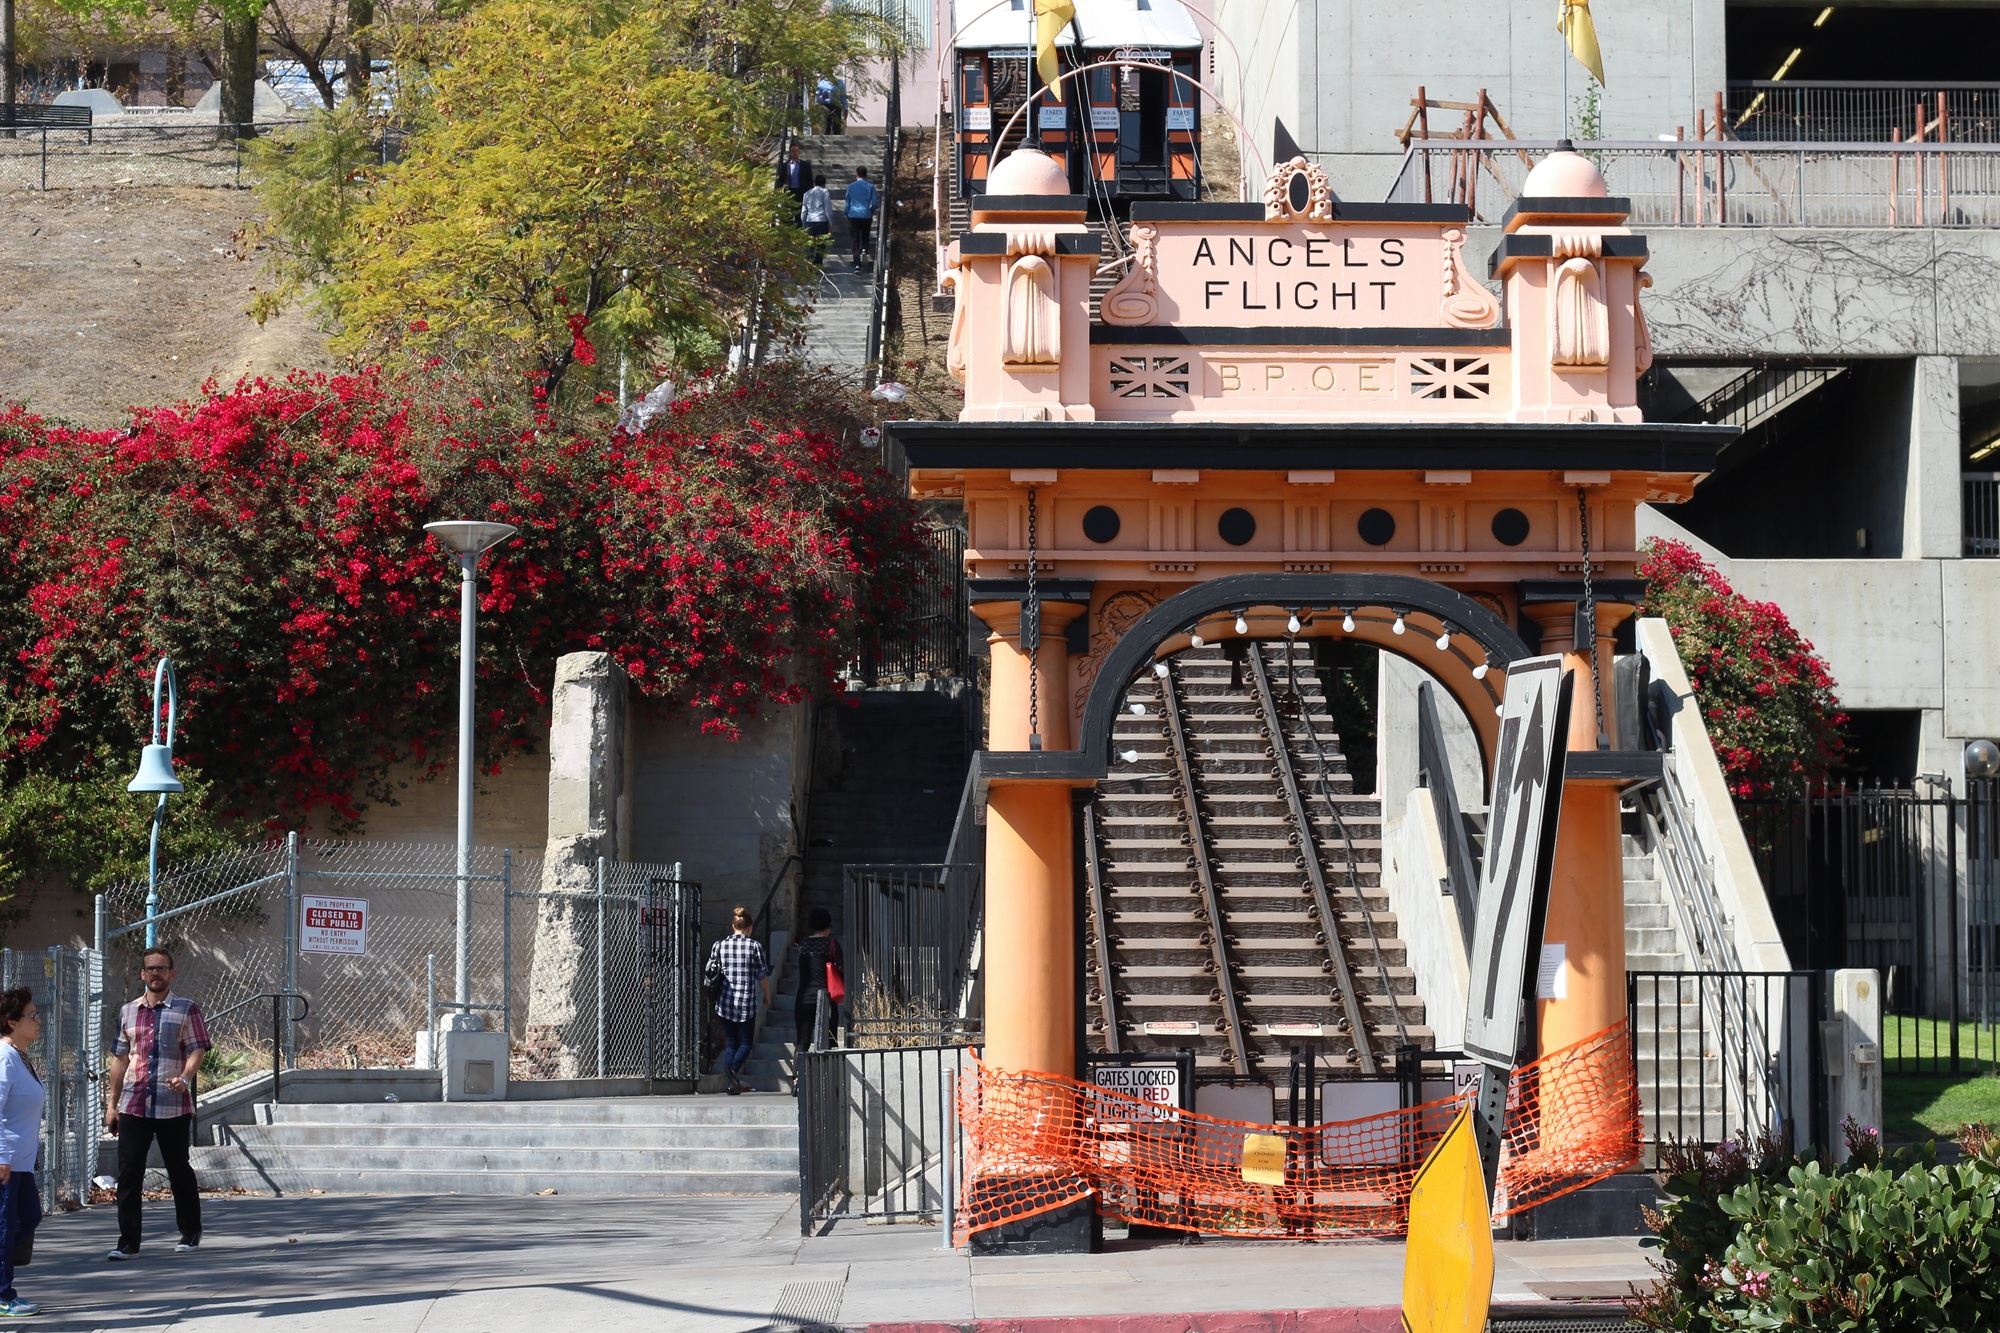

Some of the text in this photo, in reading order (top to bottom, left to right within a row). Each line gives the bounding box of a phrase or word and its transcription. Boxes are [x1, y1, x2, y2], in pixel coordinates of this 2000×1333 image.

[1192, 237, 1405, 267] ANGELS
[1205, 280, 1396, 310] FLIGHT
[316, 900, 355, 909] THIS PROPERTY
[312, 910, 357, 920] CLOSED TO
[310, 918, 358, 928] THE PUBLIC
[308, 936, 358, 946] WITHOUT PERMISSION
[1097, 1070, 1176, 1086] GATES LOCKED
[1102, 1087, 1170, 1101] WHEN RED
[1101, 1103, 1141, 1119] LIGHT
